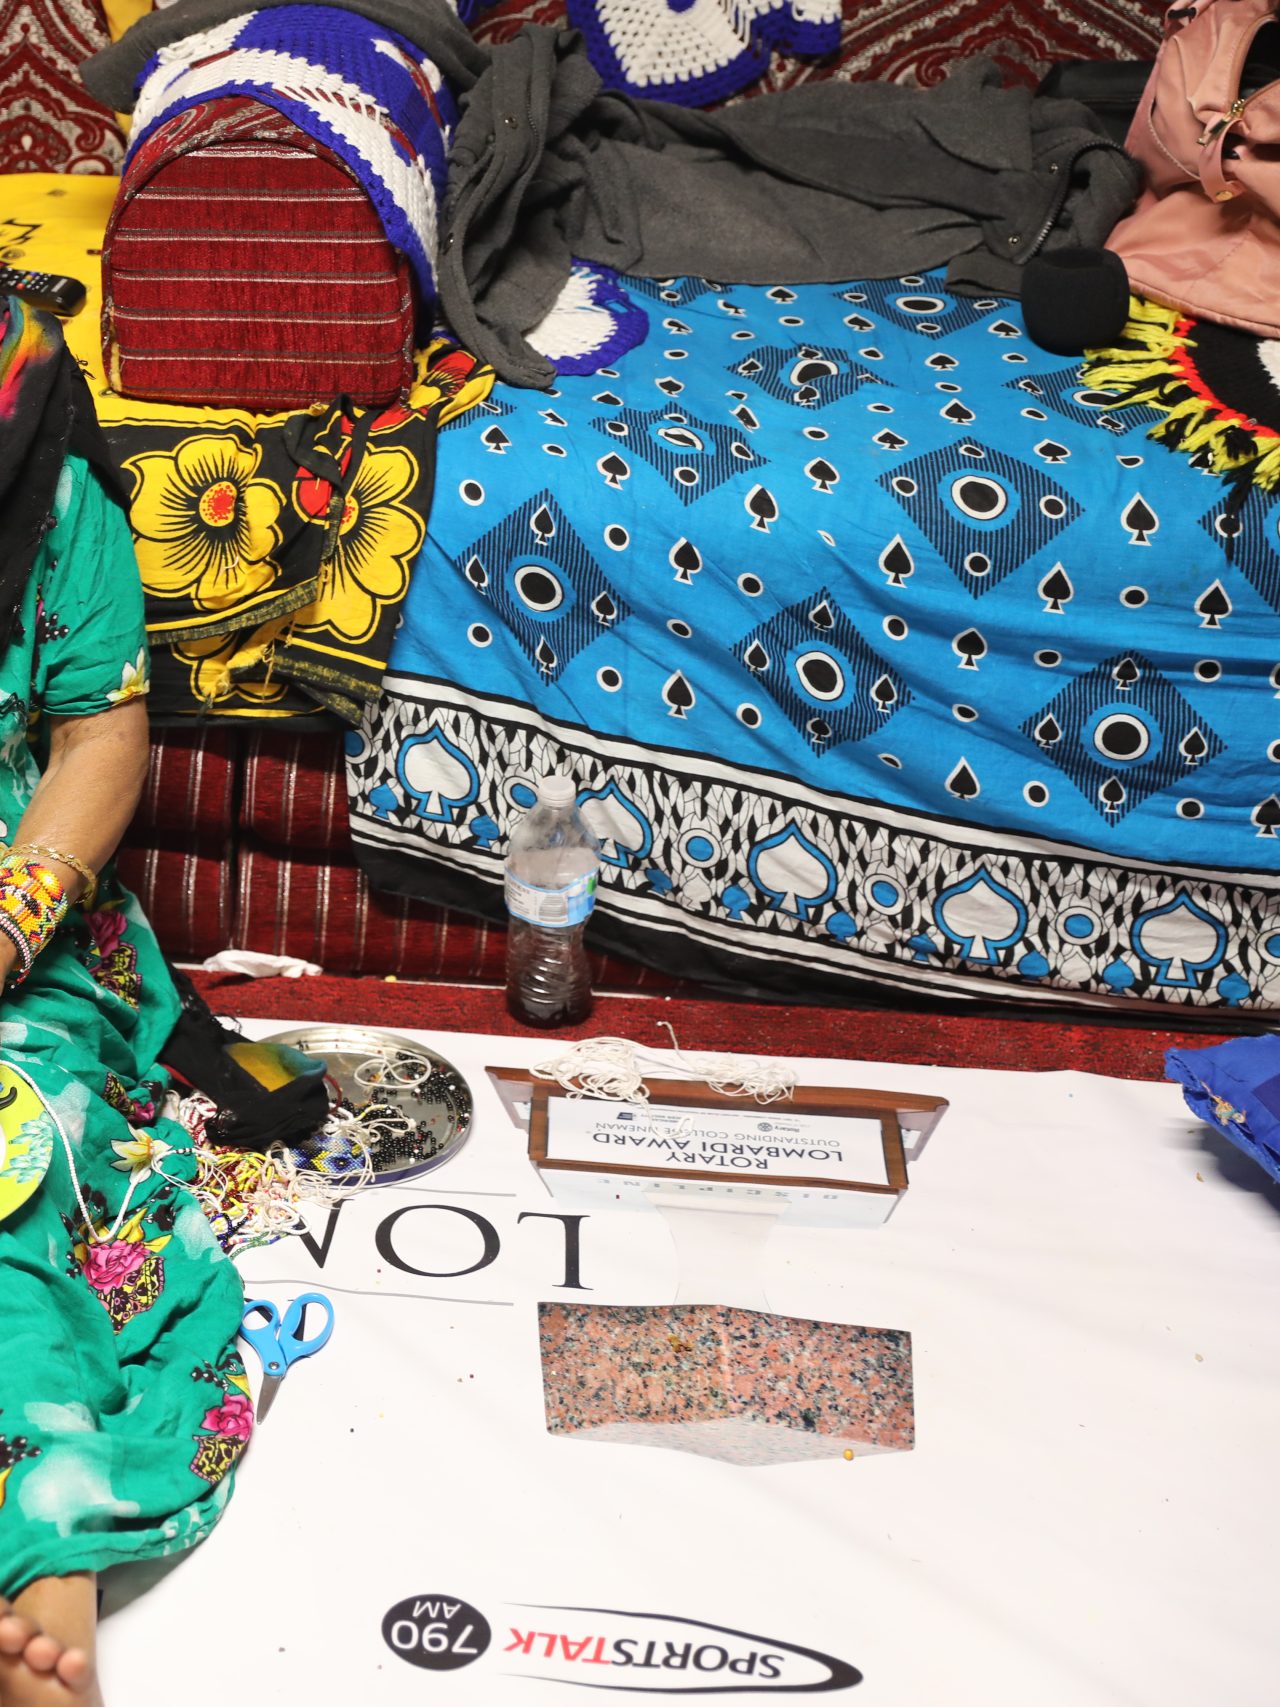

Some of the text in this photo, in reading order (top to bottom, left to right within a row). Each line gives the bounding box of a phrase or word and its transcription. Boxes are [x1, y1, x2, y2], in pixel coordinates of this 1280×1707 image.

[664, 1125, 729, 1139] COLLE
[732, 1133, 841, 1148] OUTSTANDING
[592, 1131, 843, 1163] LOMBARDI AWARD
[666, 1150, 769, 1170] ROTARY
[412, 1599, 463, 1618] AM
[391, 1619, 481, 1655] 790
[501, 1626, 786, 1680] SPORTSTALK
